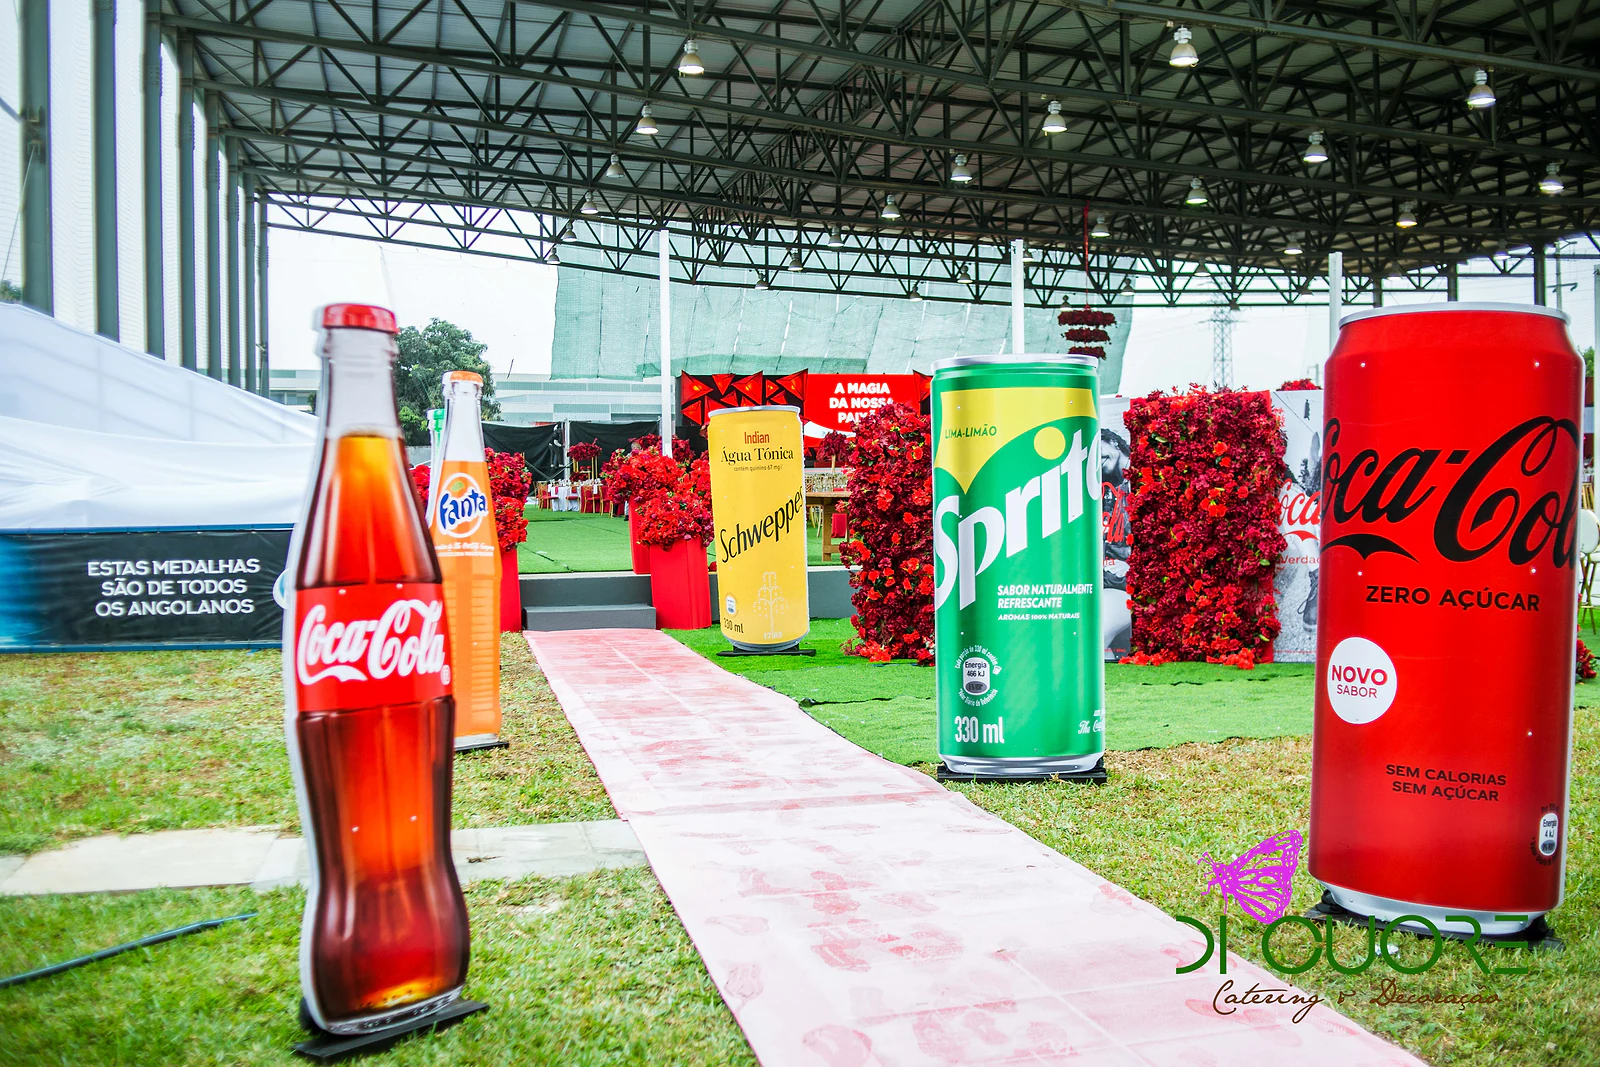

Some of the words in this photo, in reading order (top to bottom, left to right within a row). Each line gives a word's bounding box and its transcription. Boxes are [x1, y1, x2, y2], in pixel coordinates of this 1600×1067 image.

[834, 383, 845, 394] A
[848, 383, 890, 394] MAGIA
[828, 398, 849, 409] DA
[744, 432, 770, 444] Indian
[944, 424, 997, 439] LIMA-LIMÃO
[720, 447, 752, 466] Água
[753, 447, 794, 461] Tónica
[87, 560, 150, 577] ESTAS
[152, 558, 261, 575] MEDALHAS
[101, 577, 144, 596] SÃO
[147, 580, 176, 595] DE
[177, 578, 248, 595] TODOS
[997, 584, 1030, 596] SABOR
[1031, 583, 1093, 595] NATURALMENTE
[997, 597, 1062, 609] REFRESCANTE
[1365, 585, 1431, 605] ZERO
[1438, 587, 1540, 611] AÇÚCAR
[95, 601, 125, 617] OS
[127, 599, 256, 616] ANGOLANOS
[998, 613, 1029, 621] AROMAS
[1048, 612, 1080, 620] NATURAIS
[734, 622, 744, 633] ml
[296, 599, 446, 686] Coca-Cola
[964, 661, 987, 669] Energia
[1331, 664, 1388, 686] NOVO
[1336, 684, 1377, 699] SABOR
[954, 715, 979, 743] 330
[982, 716, 1005, 744] ml
[1386, 764, 1420, 779] SEM
[1425, 768, 1507, 786] CALORIAS
[1392, 780, 1427, 795] SEM
[1431, 785, 1499, 802] AÇÚCAR
